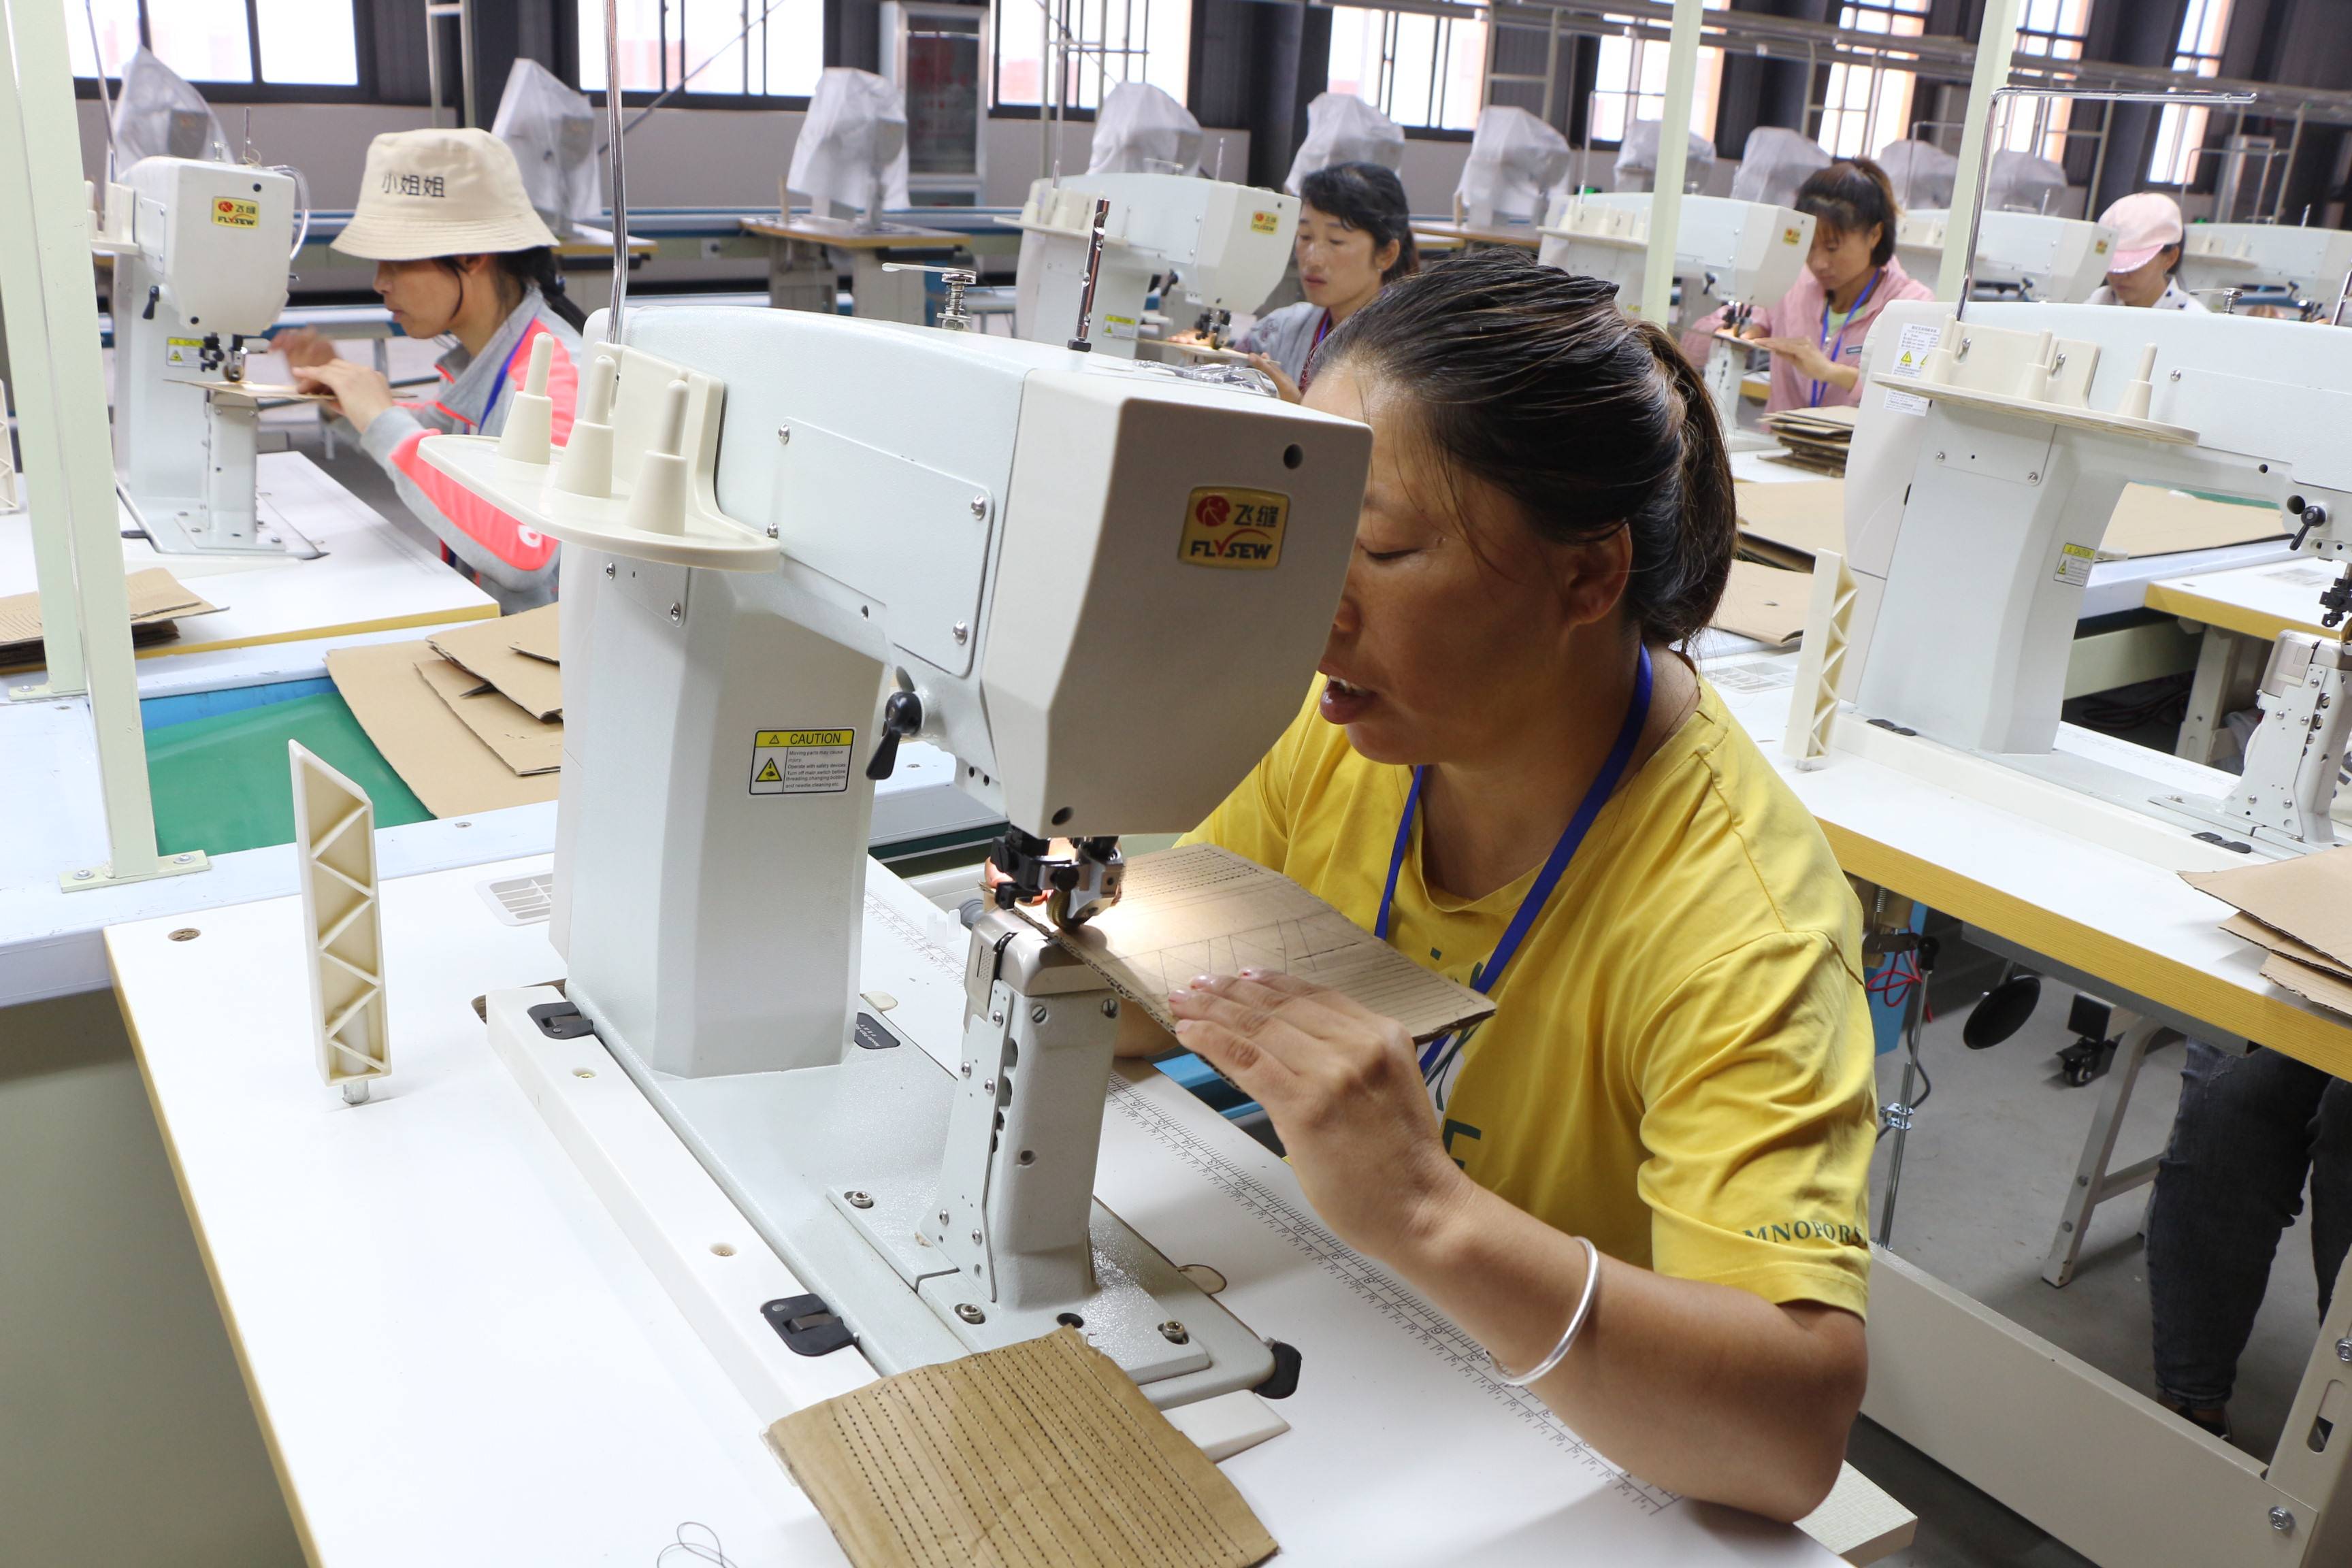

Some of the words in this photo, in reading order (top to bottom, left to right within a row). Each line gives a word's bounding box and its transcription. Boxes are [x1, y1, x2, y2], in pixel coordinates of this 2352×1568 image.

[382, 173, 446, 197] 小姐姐
[218, 215, 255, 226] FLYSEW
[1234, 504, 1279, 528] 飞缝
[1190, 538, 1273, 560] FLYSEW
[790, 733, 841, 745] CAUTION
[1207, 1160, 1224, 1170] 13
[1235, 1180, 1251, 1191] 12
[1293, 1224, 1309, 1235] 10
